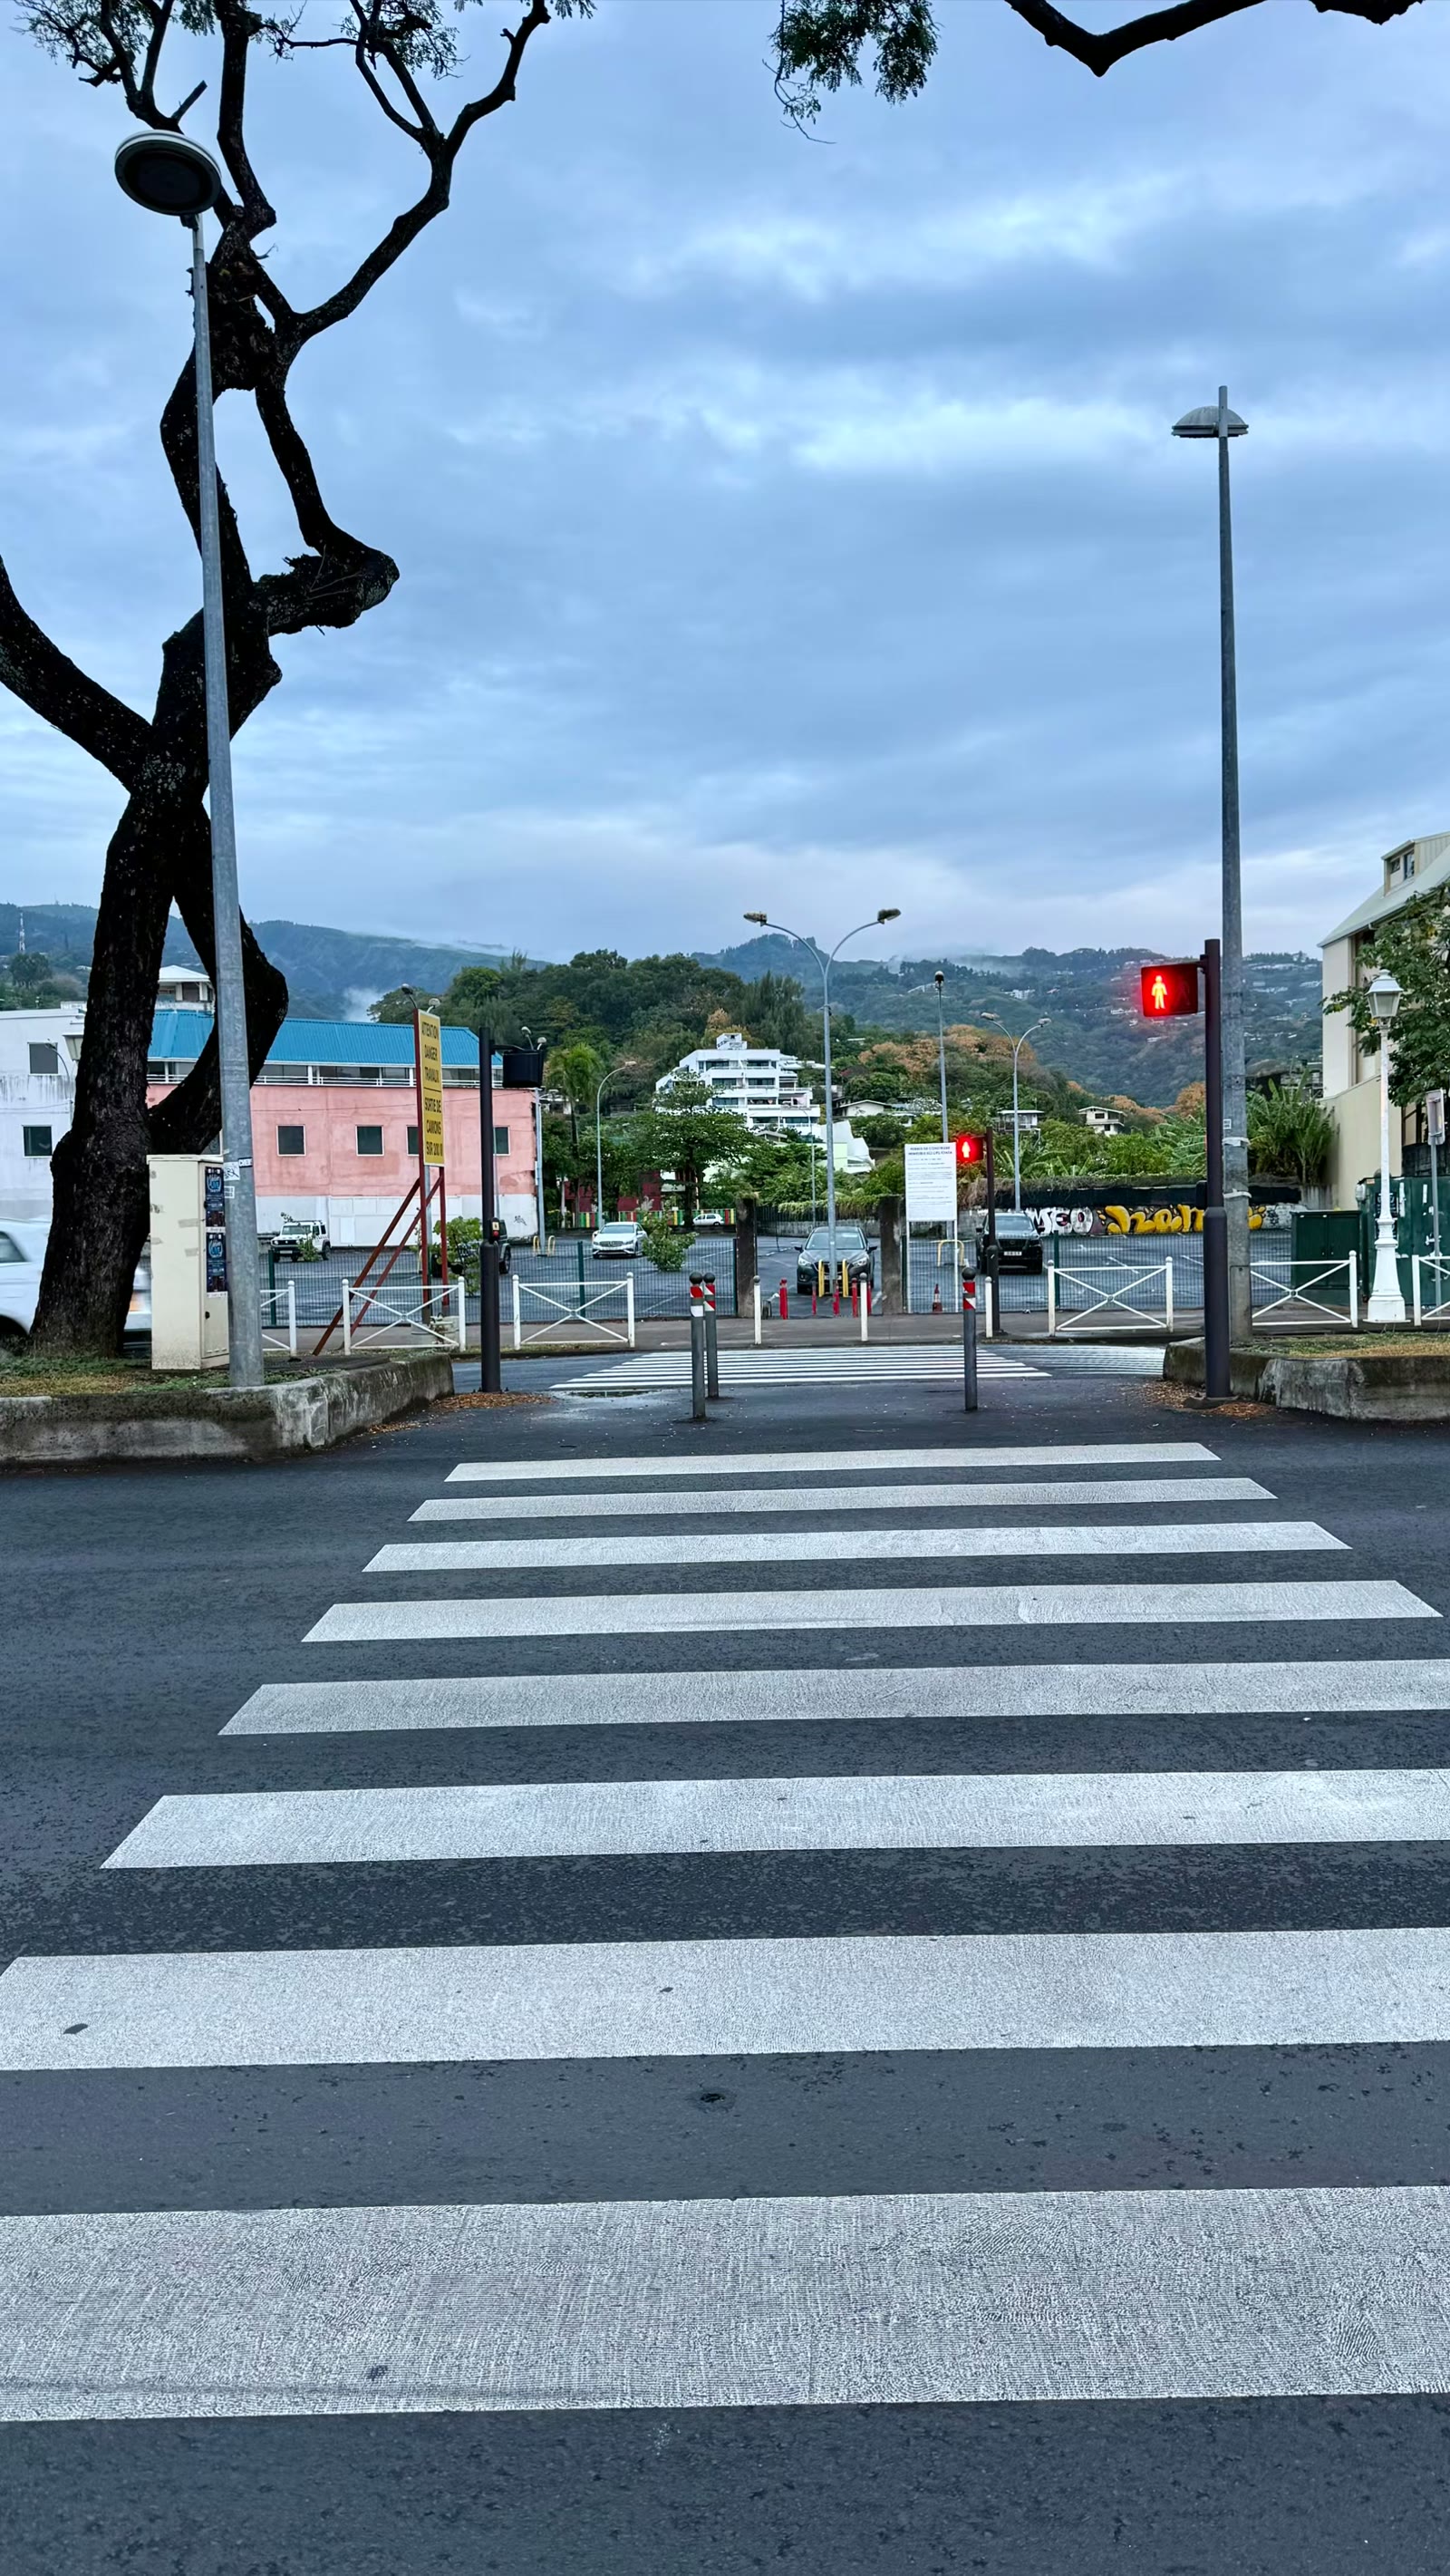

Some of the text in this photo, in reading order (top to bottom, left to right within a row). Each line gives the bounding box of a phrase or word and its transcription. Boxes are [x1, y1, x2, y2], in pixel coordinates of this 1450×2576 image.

[424, 1044, 438, 1060] DANGER
[424, 1097, 441, 1113] SORTIE DE
